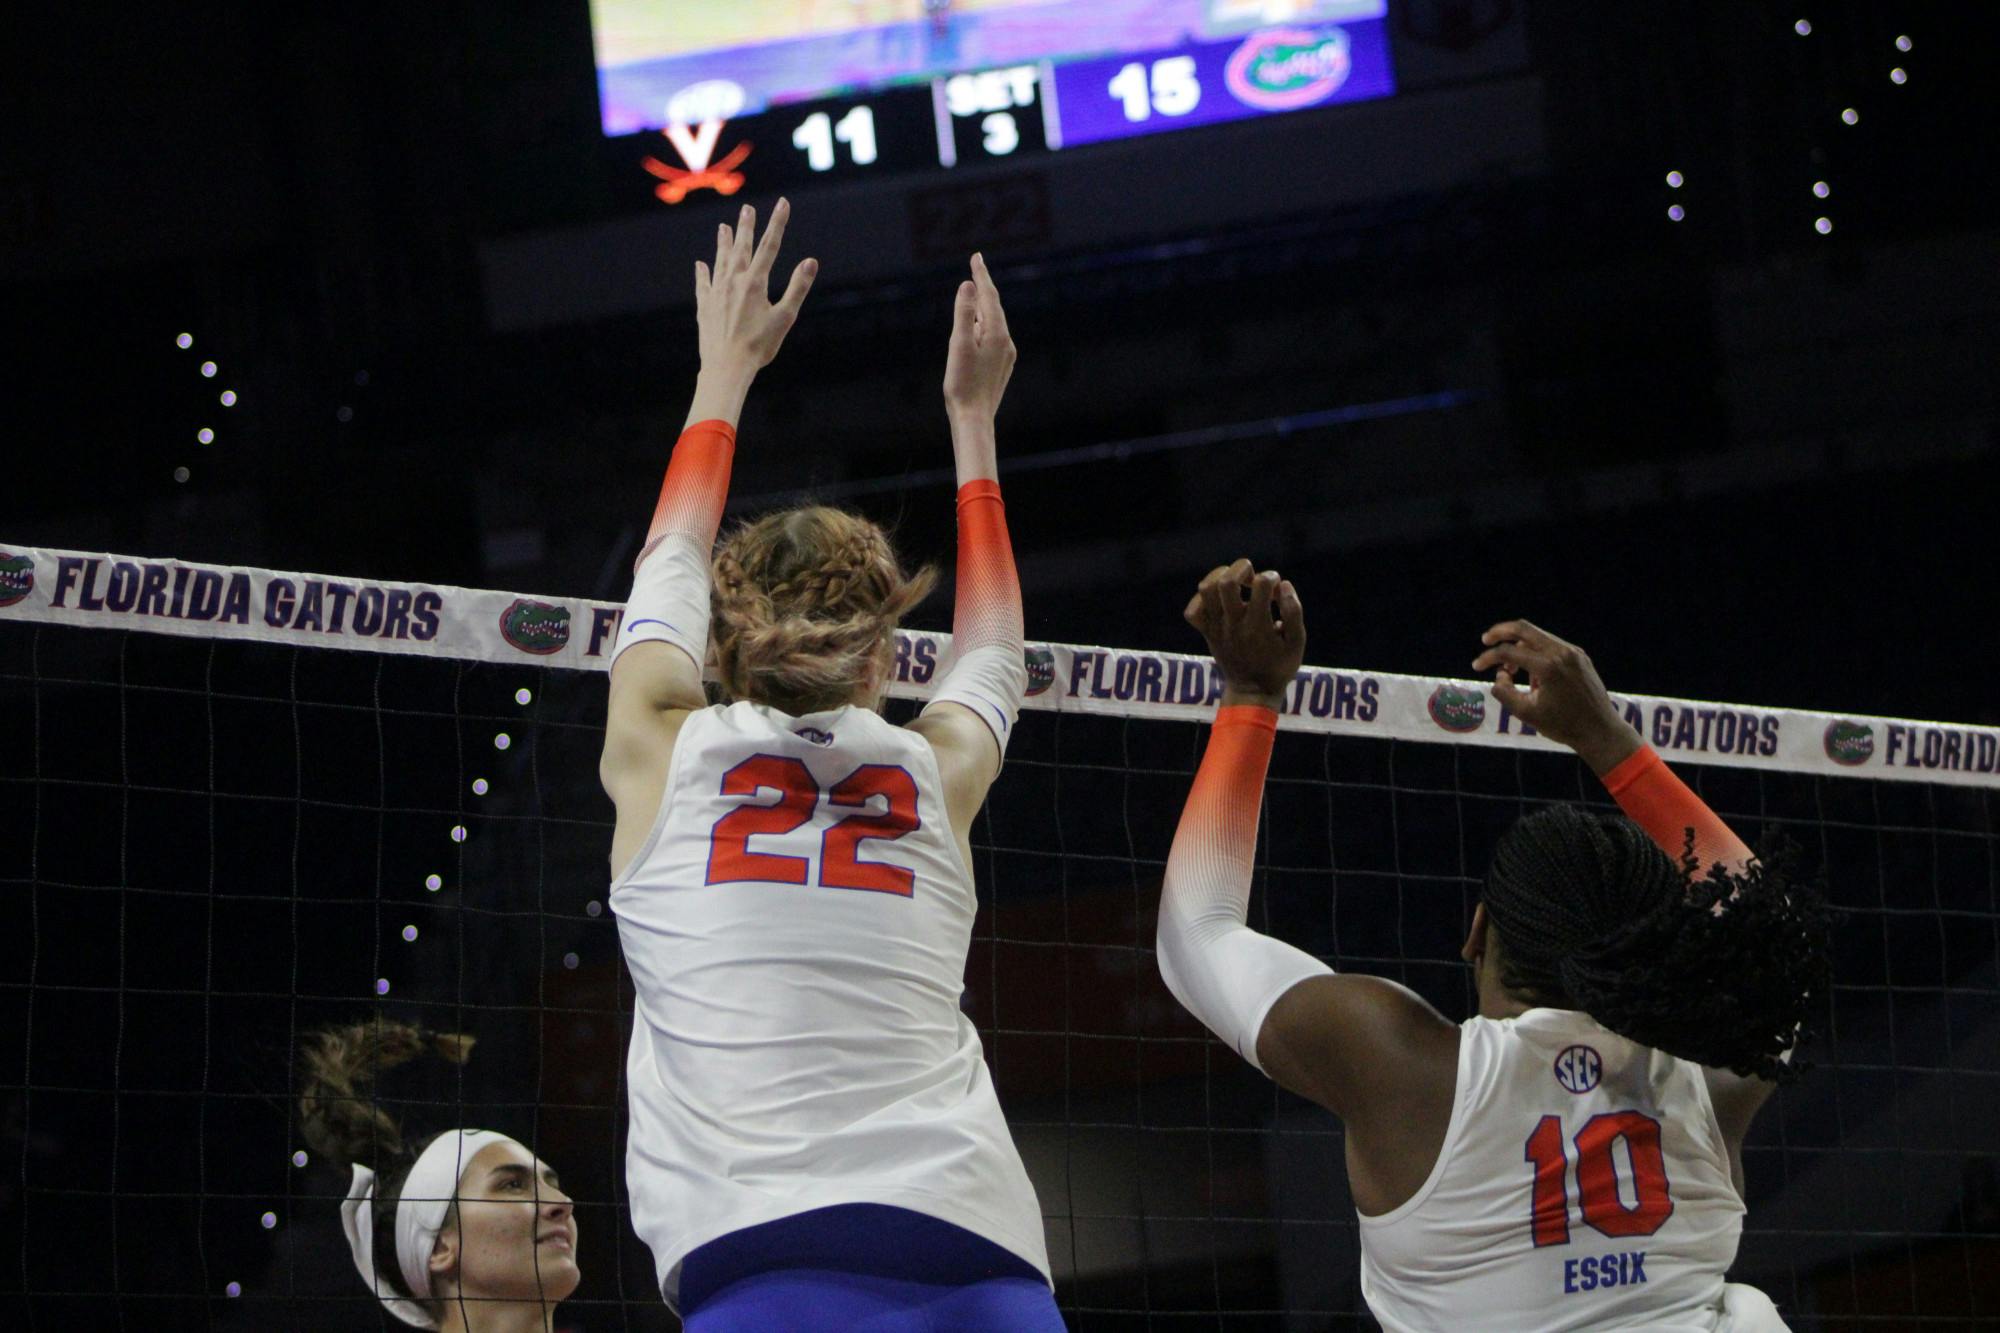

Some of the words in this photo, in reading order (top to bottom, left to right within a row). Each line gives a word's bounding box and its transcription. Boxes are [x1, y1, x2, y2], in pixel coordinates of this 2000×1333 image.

[945, 66, 1039, 117] SET
[1109, 56, 1200, 122] 15
[793, 106, 878, 171] 11
[981, 112, 1019, 156] 3
[49, 557, 250, 625] FLORIDA
[264, 577, 444, 642] GATORS
[1280, 671, 1380, 723] TORS
[1651, 705, 1780, 758] GATORS
[1885, 723, 2000, 775] FLORID
[704, 752, 922, 900] 22
[1555, 1045, 1603, 1094] SEC
[1525, 1110, 1674, 1249] 10
[1564, 1251, 1648, 1294] ESSIX
